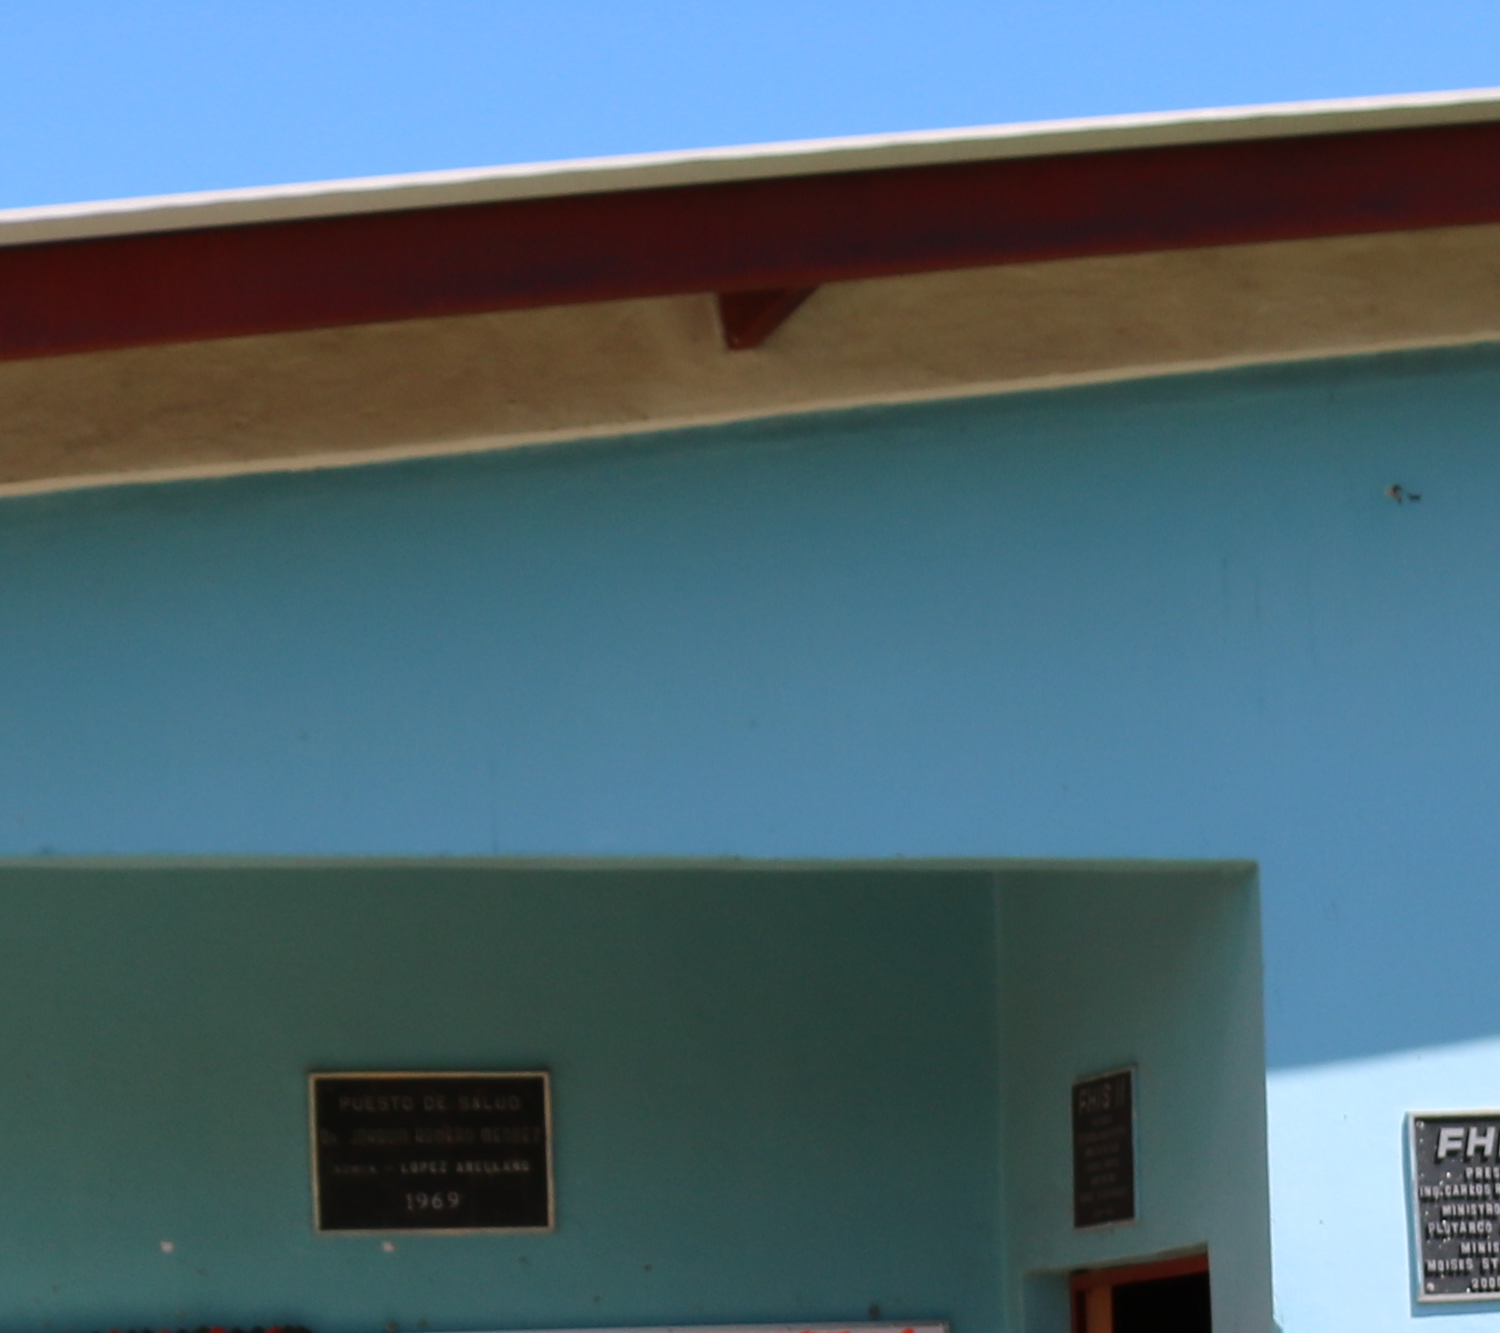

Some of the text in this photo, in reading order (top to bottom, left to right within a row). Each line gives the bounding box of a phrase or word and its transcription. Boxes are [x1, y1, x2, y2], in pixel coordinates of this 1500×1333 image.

[339, 1095, 414, 1112] PUESTO
[423, 1095, 446, 1112] DE
[405, 1191, 461, 1210] 1969
[1442, 1203, 1500, 1216] MINISTRO
[1428, 1221, 1493, 1234] PLUTARCO
[1426, 1258, 1474, 1272] MOISES
